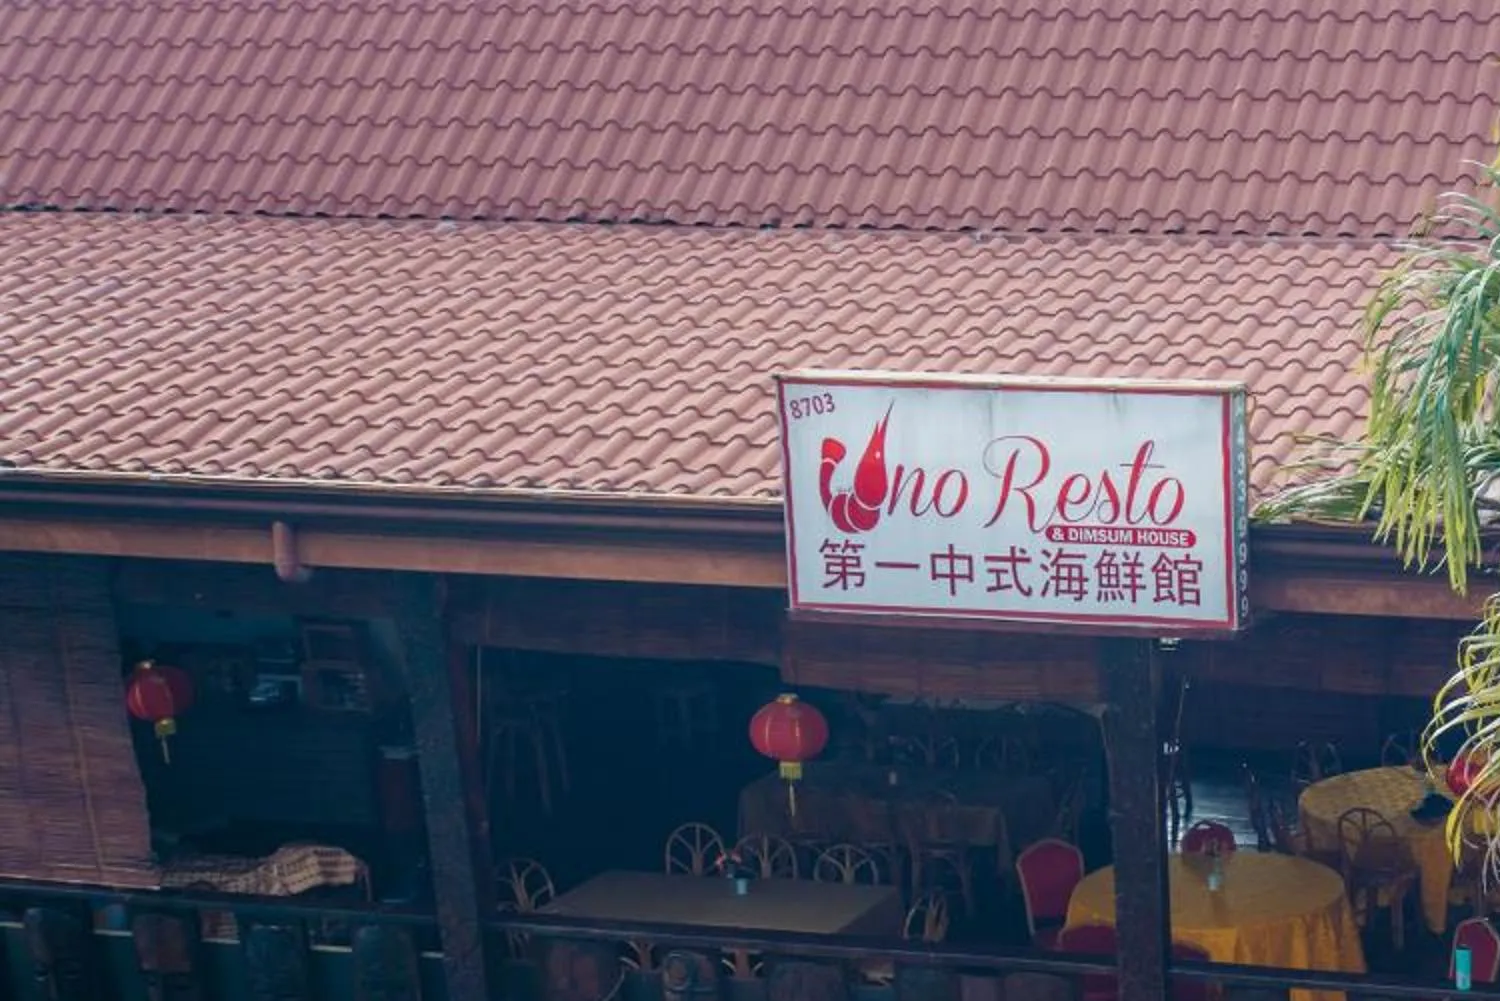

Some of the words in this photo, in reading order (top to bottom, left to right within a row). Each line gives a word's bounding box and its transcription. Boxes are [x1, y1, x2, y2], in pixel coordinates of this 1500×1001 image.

[790, 393, 836, 420] 8703
[819, 398, 969, 534] Uno
[982, 435, 1186, 534] Resto
[1052, 527, 1066, 541] &
[1068, 528, 1134, 544] DIMSUM
[1137, 531, 1189, 547] HOUSE
[819, 539, 1203, 606] 第一中式海鮮館
